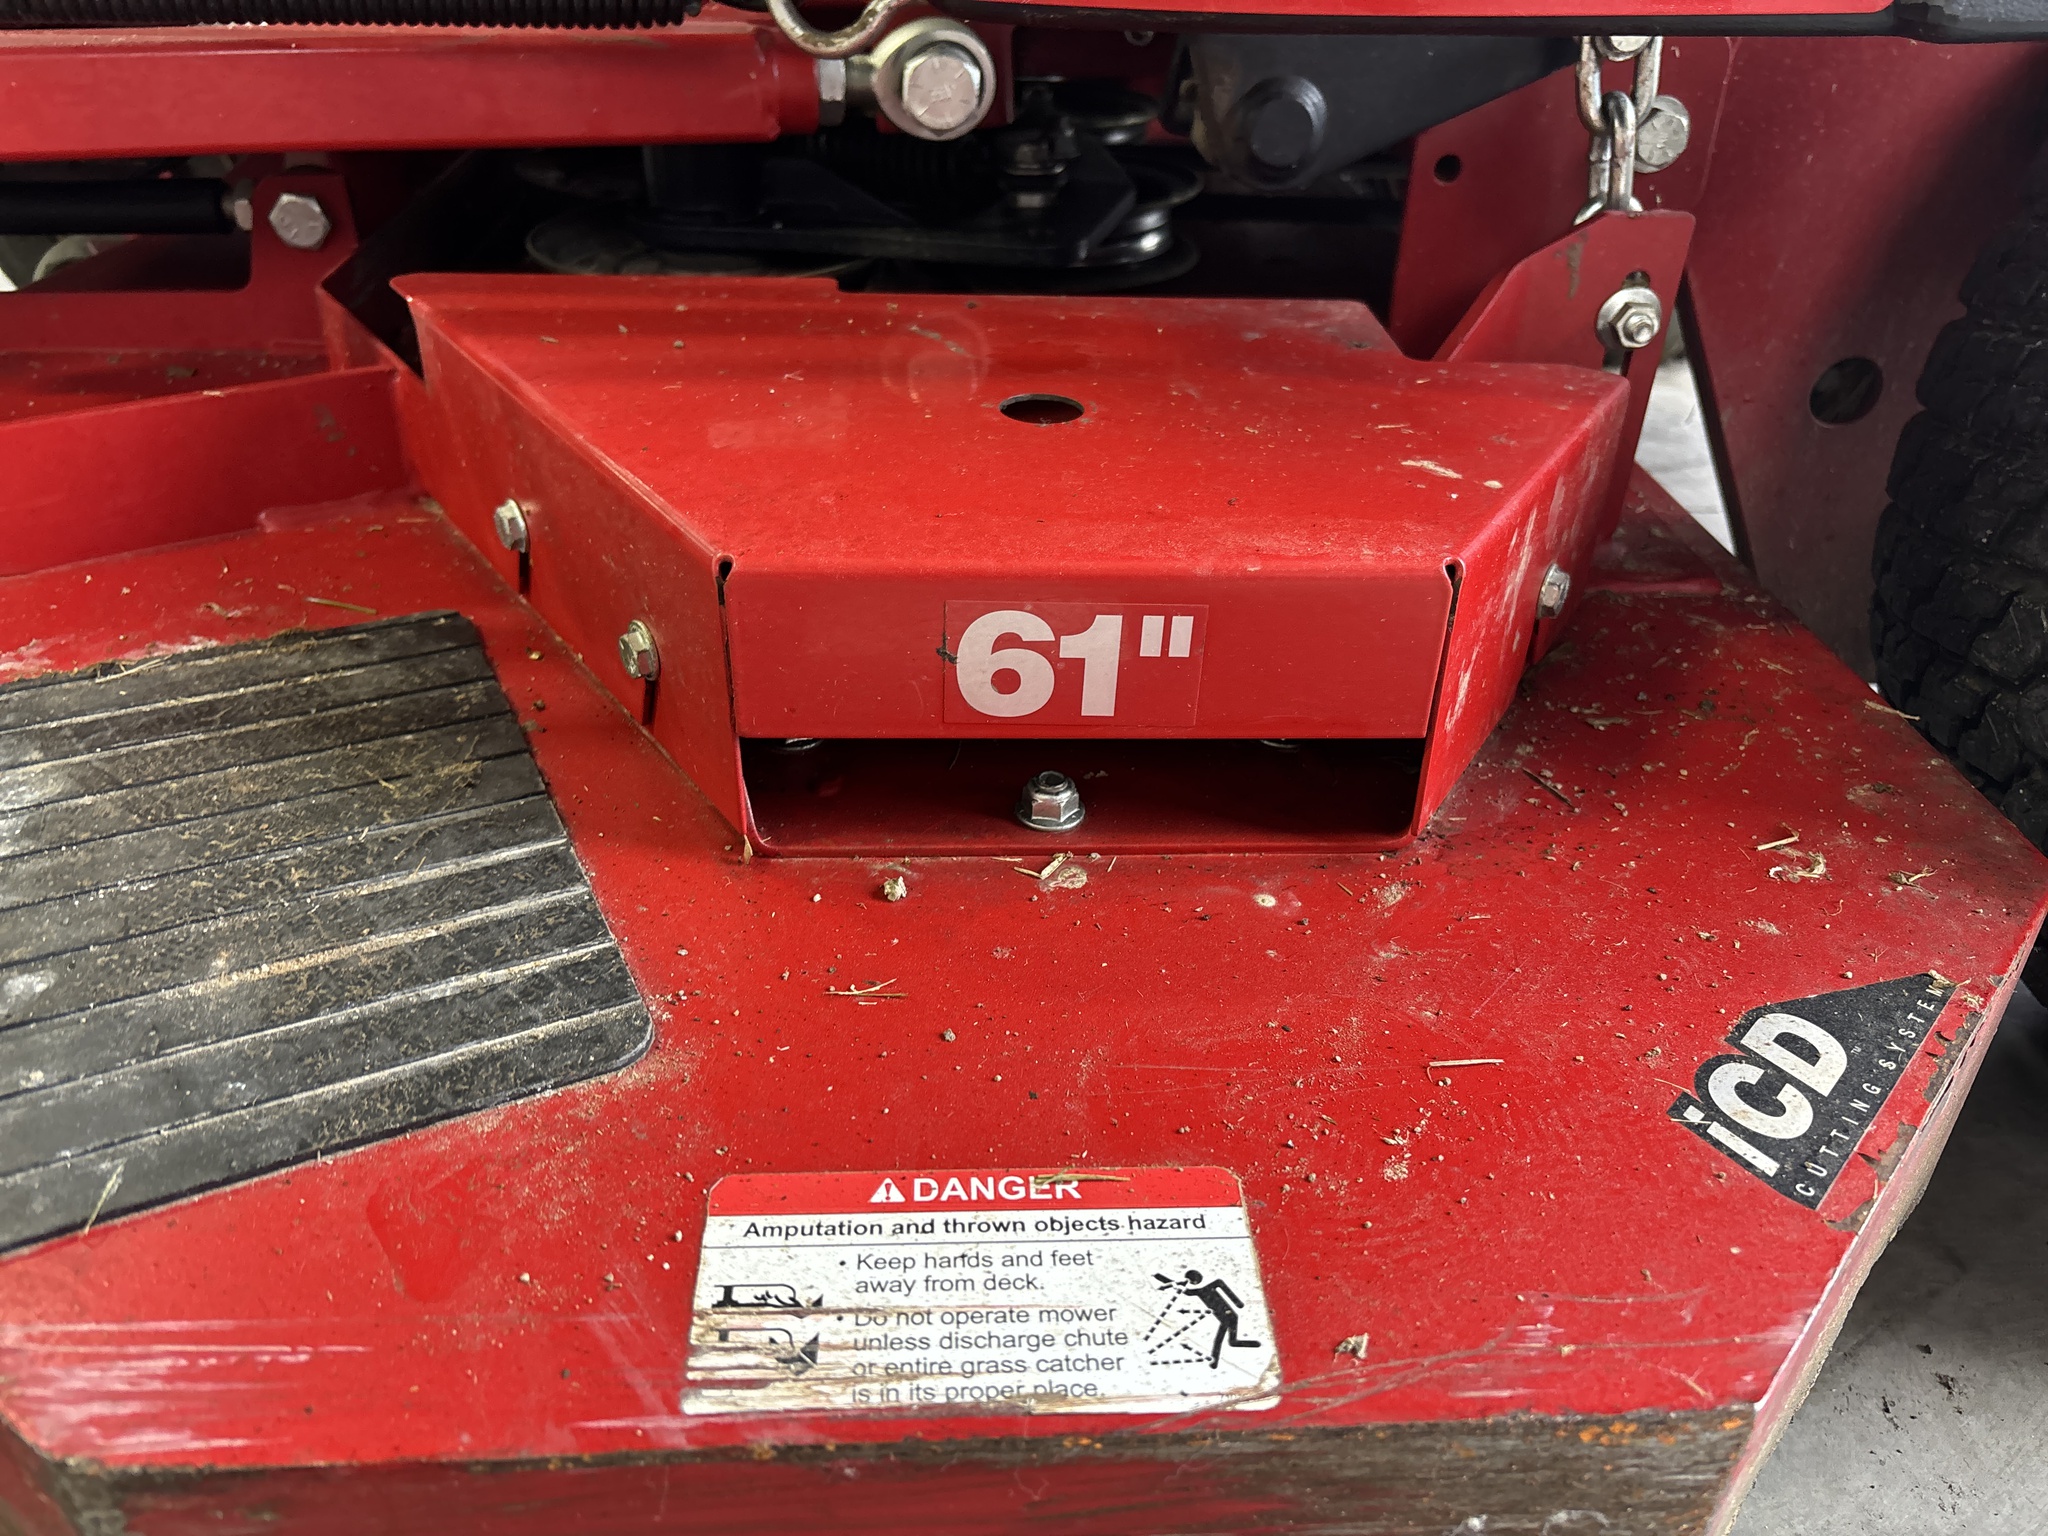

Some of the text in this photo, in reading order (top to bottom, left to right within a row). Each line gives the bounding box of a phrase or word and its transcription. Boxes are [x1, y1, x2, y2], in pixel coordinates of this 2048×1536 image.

[956, 609, 1195, 718] 61"
[1683, 1013, 1848, 1178] iCD
[1795, 984, 1946, 1198] CUTTING SYSTEM
[913, 1176, 1082, 1203] DANGER
[743, 1213, 1207, 1241] Amputation and thrown objects hazard
[856, 1249, 1095, 1274] Keep hands and feet
[855, 1272, 1045, 1297] away from deck.
[854, 1307, 1118, 1330] Do not operate mower
[853, 1328, 1129, 1353] unless discharge chute
[851, 1352, 1125, 1379] or entire grass catcher
[851, 1387, 871, 1403] is
[879, 1383, 900, 1403] in
[909, 1382, 937, 1402] its
[945, 1384, 1026, 1402] proper
